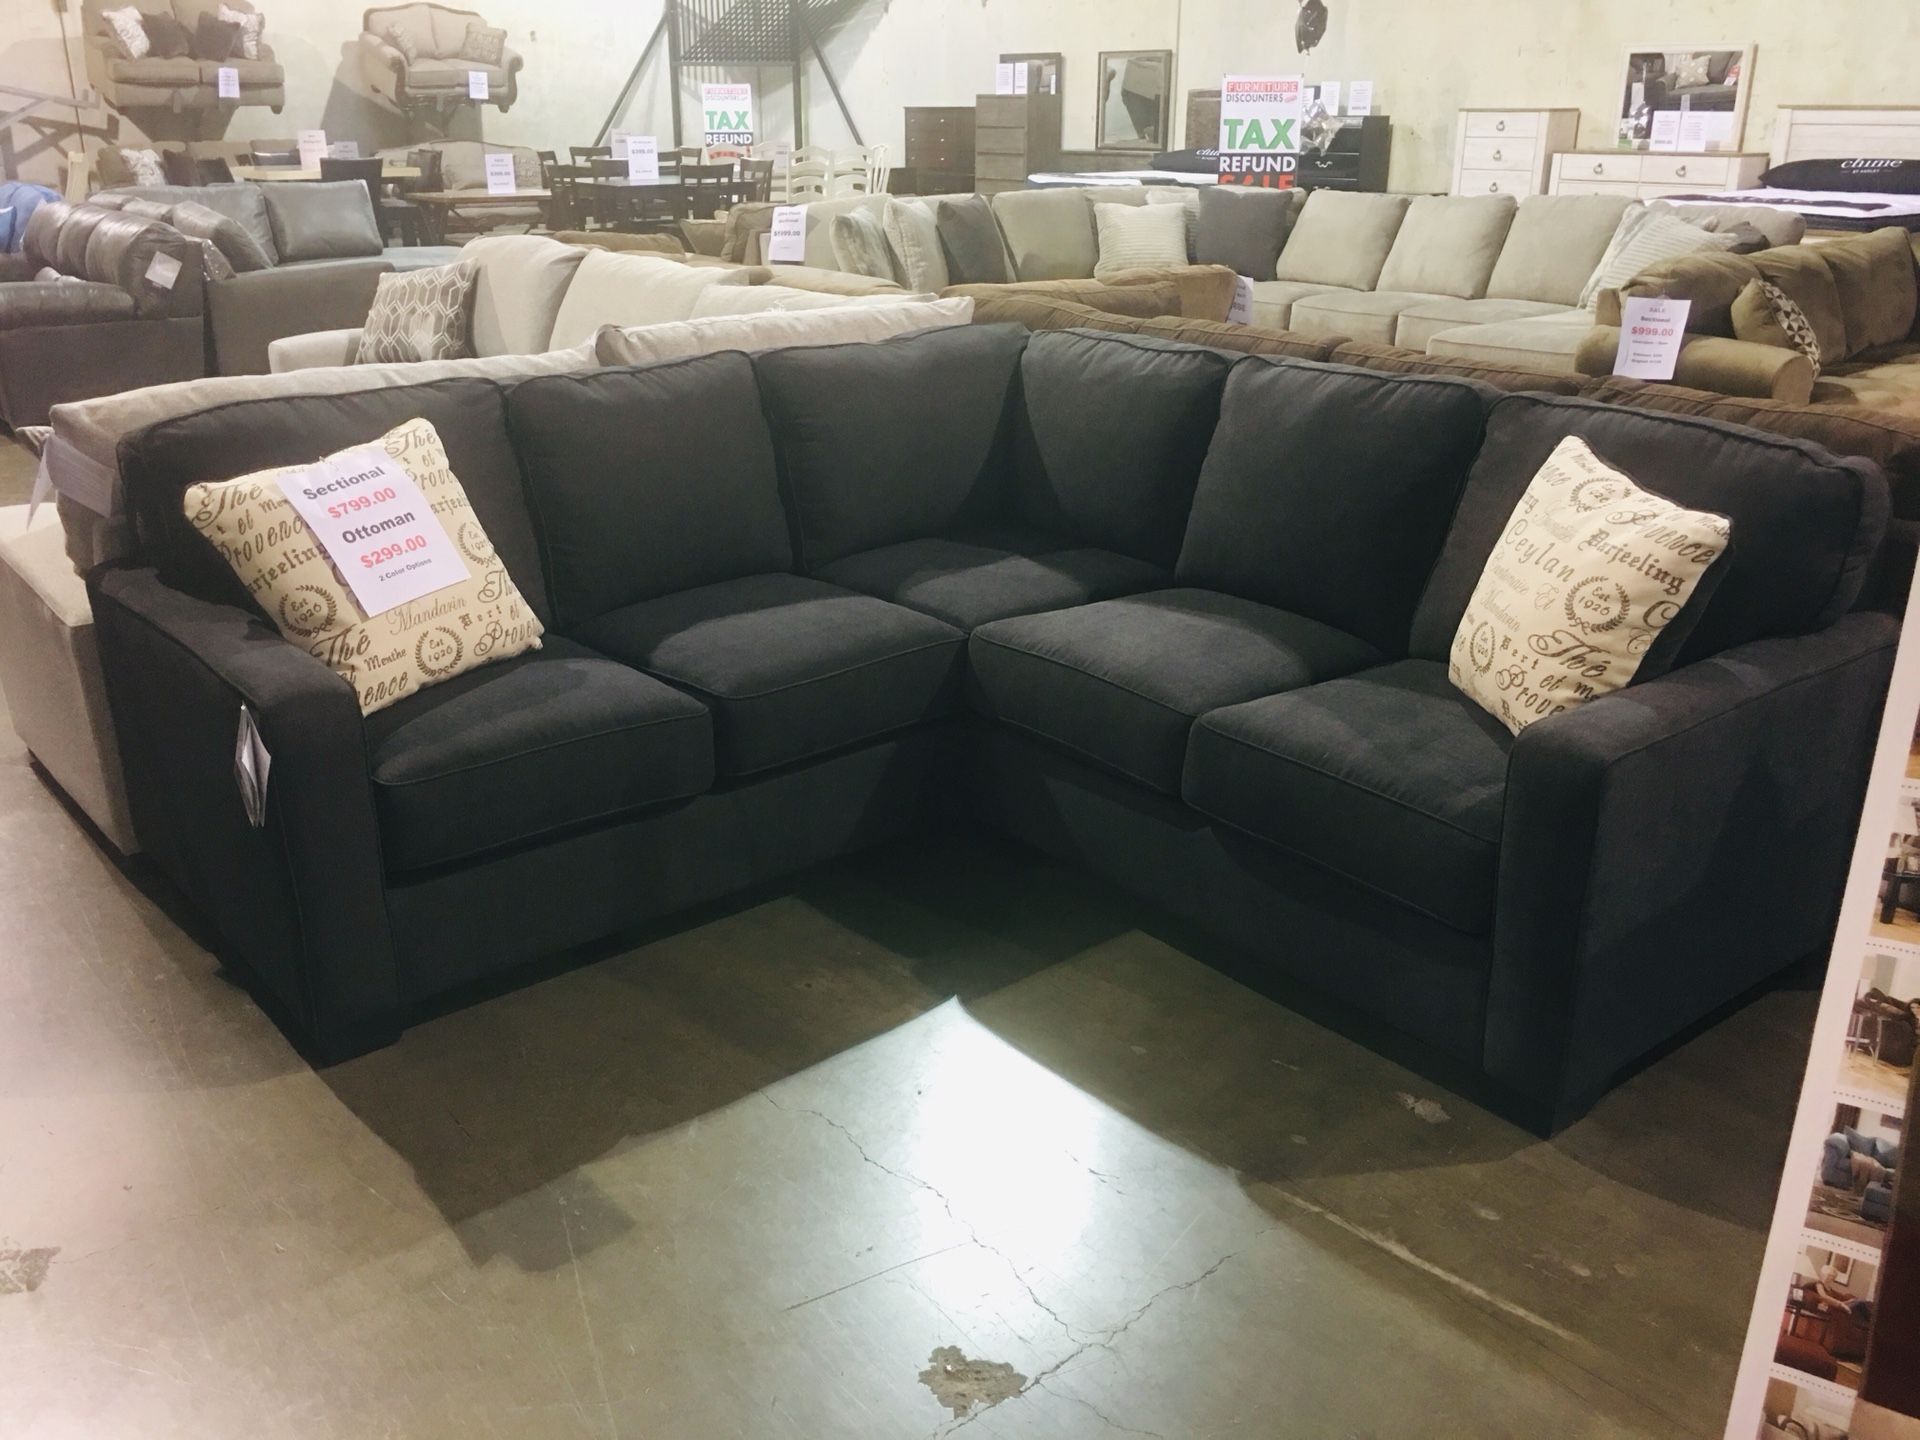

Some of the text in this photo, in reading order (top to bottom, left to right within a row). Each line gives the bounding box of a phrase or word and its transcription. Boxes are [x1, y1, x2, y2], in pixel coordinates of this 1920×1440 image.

[1227, 81, 1298, 92] FURNITURE
[1226, 94, 1283, 103] DISCOUNTERS
[705, 111, 750, 130] TAX
[705, 133, 753, 145] REFUND
[1223, 119, 1296, 149] TAX
[1220, 156, 1296, 172] REFUND
[1841, 156, 1902, 168] chime
[1631, 326, 1674, 336] $999.00
[302, 466, 386, 500] Sectional
[327, 487, 397, 518] $799.00
[342, 511, 416, 544] Ottoman
[360, 535, 427, 568] $299.00
[1505, 518, 1575, 583] Ceylan
[385, 567, 406, 579] Color
[406, 558, 432, 573] Options
[363, 648, 407, 672] Menthe
